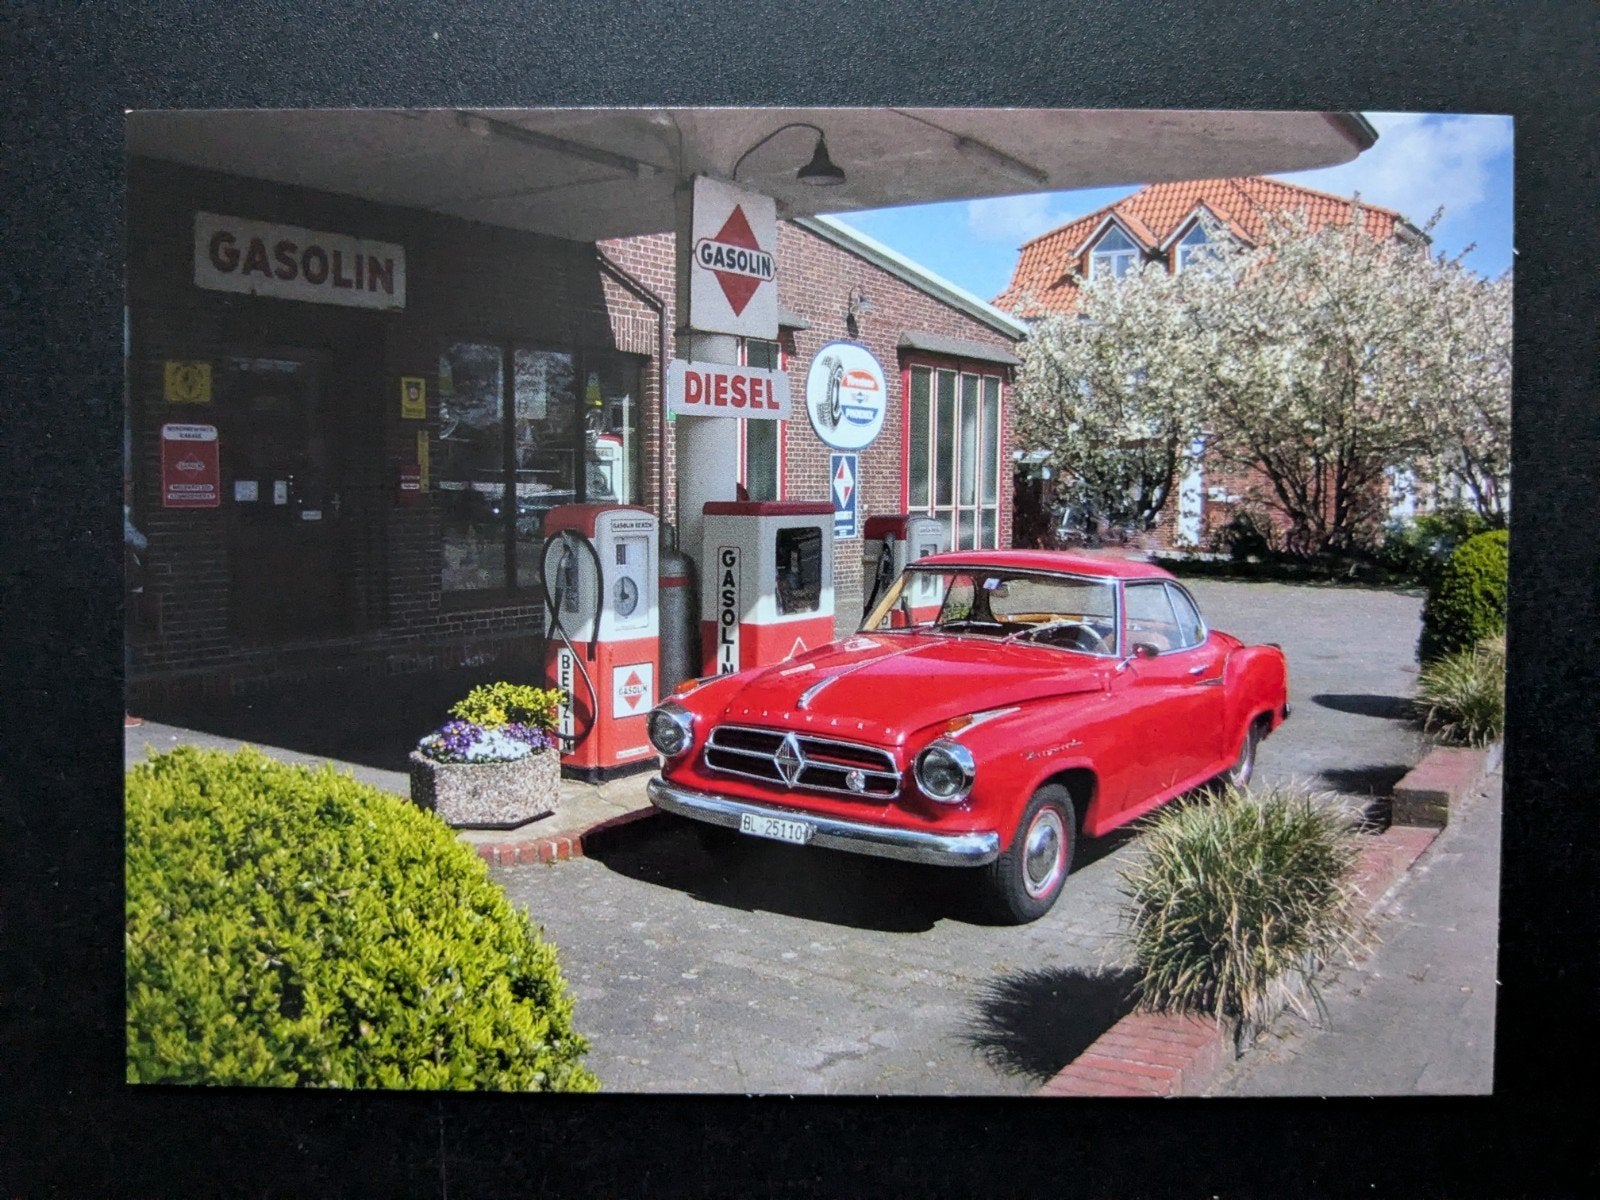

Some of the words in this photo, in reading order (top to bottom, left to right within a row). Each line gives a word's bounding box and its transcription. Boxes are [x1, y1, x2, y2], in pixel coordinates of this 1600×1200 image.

[209, 231, 394, 294] GASOLIN
[701, 243, 771, 278] GASOLIN
[685, 371, 779, 410] DIESEL
[722, 549, 736, 675] GASOLIN
[619, 685, 647, 696] GASOLIN
[743, 815, 757, 833] BL
[765, 819, 802, 841] 25110
